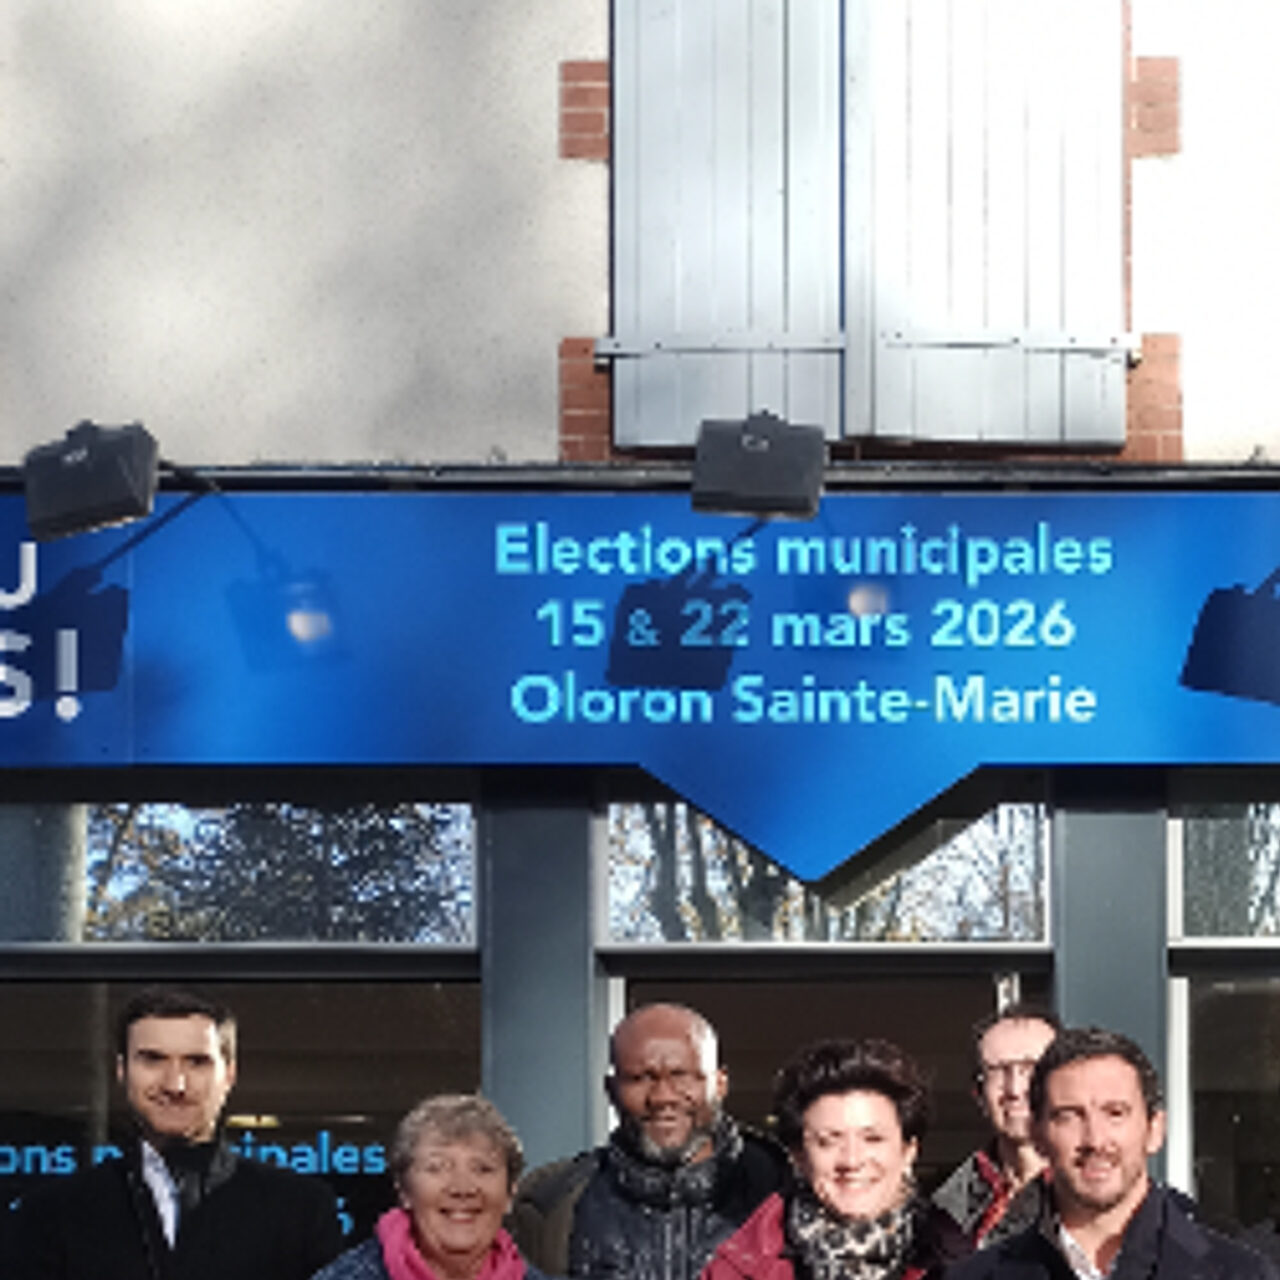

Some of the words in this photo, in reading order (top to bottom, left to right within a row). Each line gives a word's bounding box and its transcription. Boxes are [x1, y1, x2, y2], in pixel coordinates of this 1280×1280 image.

[495, 521, 758, 575] Elections
[776, 521, 1113, 588] municipales
[536, 600, 604, 647] 15
[625, 608, 661, 647] &
[680, 600, 750, 647] 22
[771, 612, 911, 647] mars
[930, 599, 1076, 647] 2026
[510, 671, 713, 723] Oloron
[731, 674, 1097, 723] Sainte-Marie
